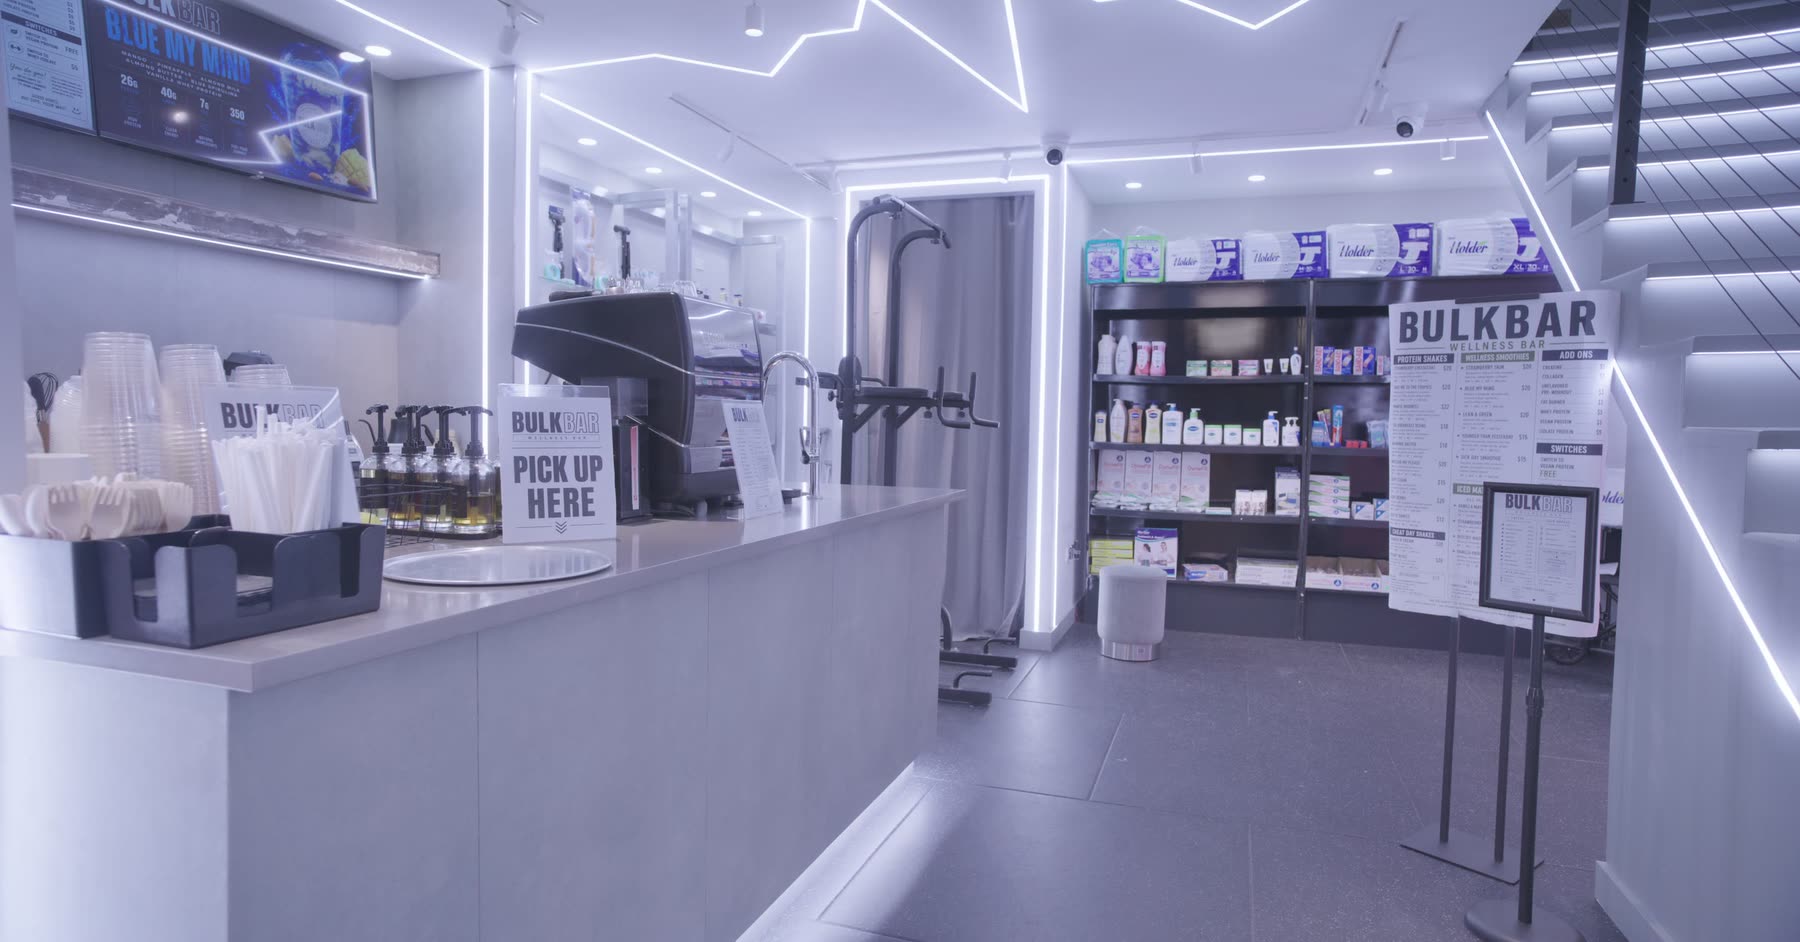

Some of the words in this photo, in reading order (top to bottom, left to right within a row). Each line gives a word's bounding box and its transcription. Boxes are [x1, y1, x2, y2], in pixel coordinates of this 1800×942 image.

[134, 0, 220, 34] KBAR
[24, 20, 58, 36] SWITCHES
[65, 46, 79, 55] FREE
[105, 6, 160, 56] BLUE
[164, 28, 196, 67] MY
[201, 41, 250, 85] MIND
[121, 50, 147, 62] MANGO
[157, 62, 192, 78] PINEAPPLE
[201, 77, 224, 89] ALMOND
[225, 84, 241, 93] MILK
[125, 58, 154, 71] ALMOND
[157, 67, 183, 80] BUTTER
[190, 78, 205, 88] BLUE
[146, 70, 175, 83] VANILLA
[176, 80, 195, 89] WHEY
[196, 86, 223, 98] PROTEIN
[229, 107, 245, 121] 350
[1339, 243, 1374, 258] Holder
[1449, 240, 1489, 255] Holder
[1253, 251, 1281, 263] Holder
[1400, 300, 1596, 343] BULKBAR
[1450, 341, 1514, 351] WELLNESS
[1521, 339, 1545, 349] BAR
[1397, 355, 1422, 363] PROTEIN
[1423, 354, 1447, 362] SHAKES
[1465, 353, 1496, 361] WELLNESS
[1496, 352, 1530, 361] SMOOTHIES
[1559, 351, 1575, 359] ADD
[1577, 350, 1593, 358] ONS
[512, 411, 600, 434] BULKBAR
[1551, 445, 1587, 454] SWITCHES
[513, 455, 569, 484] PICK
[573, 455, 603, 482] UP
[1540, 470, 1557, 478] FREE
[1457, 485, 1471, 493] ICED
[528, 487, 596, 519] HERE
[1505, 493, 1573, 513] BULKBAR
